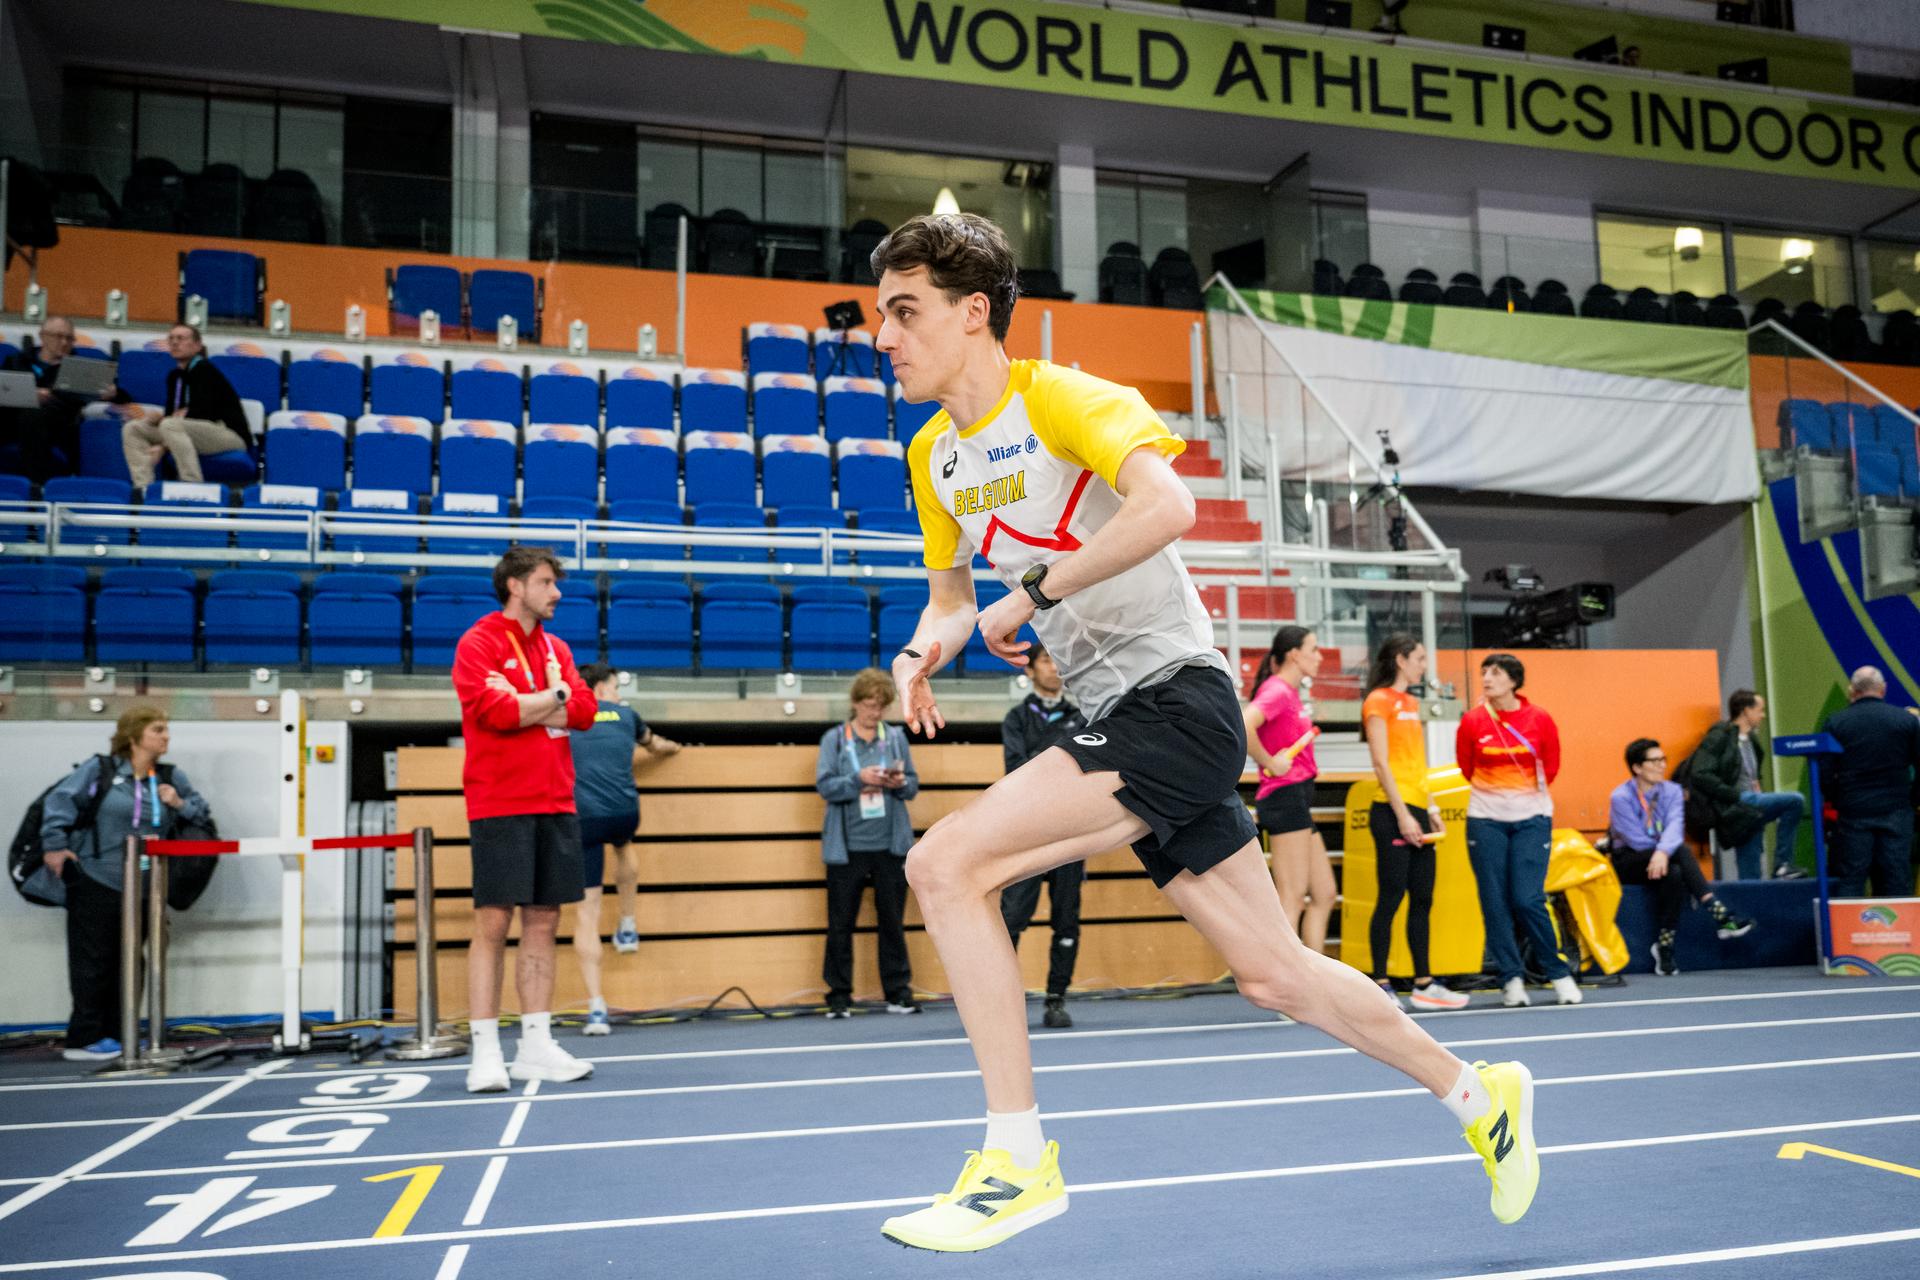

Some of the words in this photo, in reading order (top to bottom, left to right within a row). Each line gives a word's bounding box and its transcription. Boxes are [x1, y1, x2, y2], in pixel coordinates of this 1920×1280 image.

[883, 0, 1189, 91] WORLD
[1213, 40, 1613, 141] ATHLETICS
[1630, 90, 1886, 173] INDOOR
[987, 443, 1023, 464] Allianz
[953, 469, 1028, 518] BELGIUM
[299, 1073, 432, 1107] 6
[224, 1111, 390, 1161] 5
[123, 1175, 338, 1248] 4
